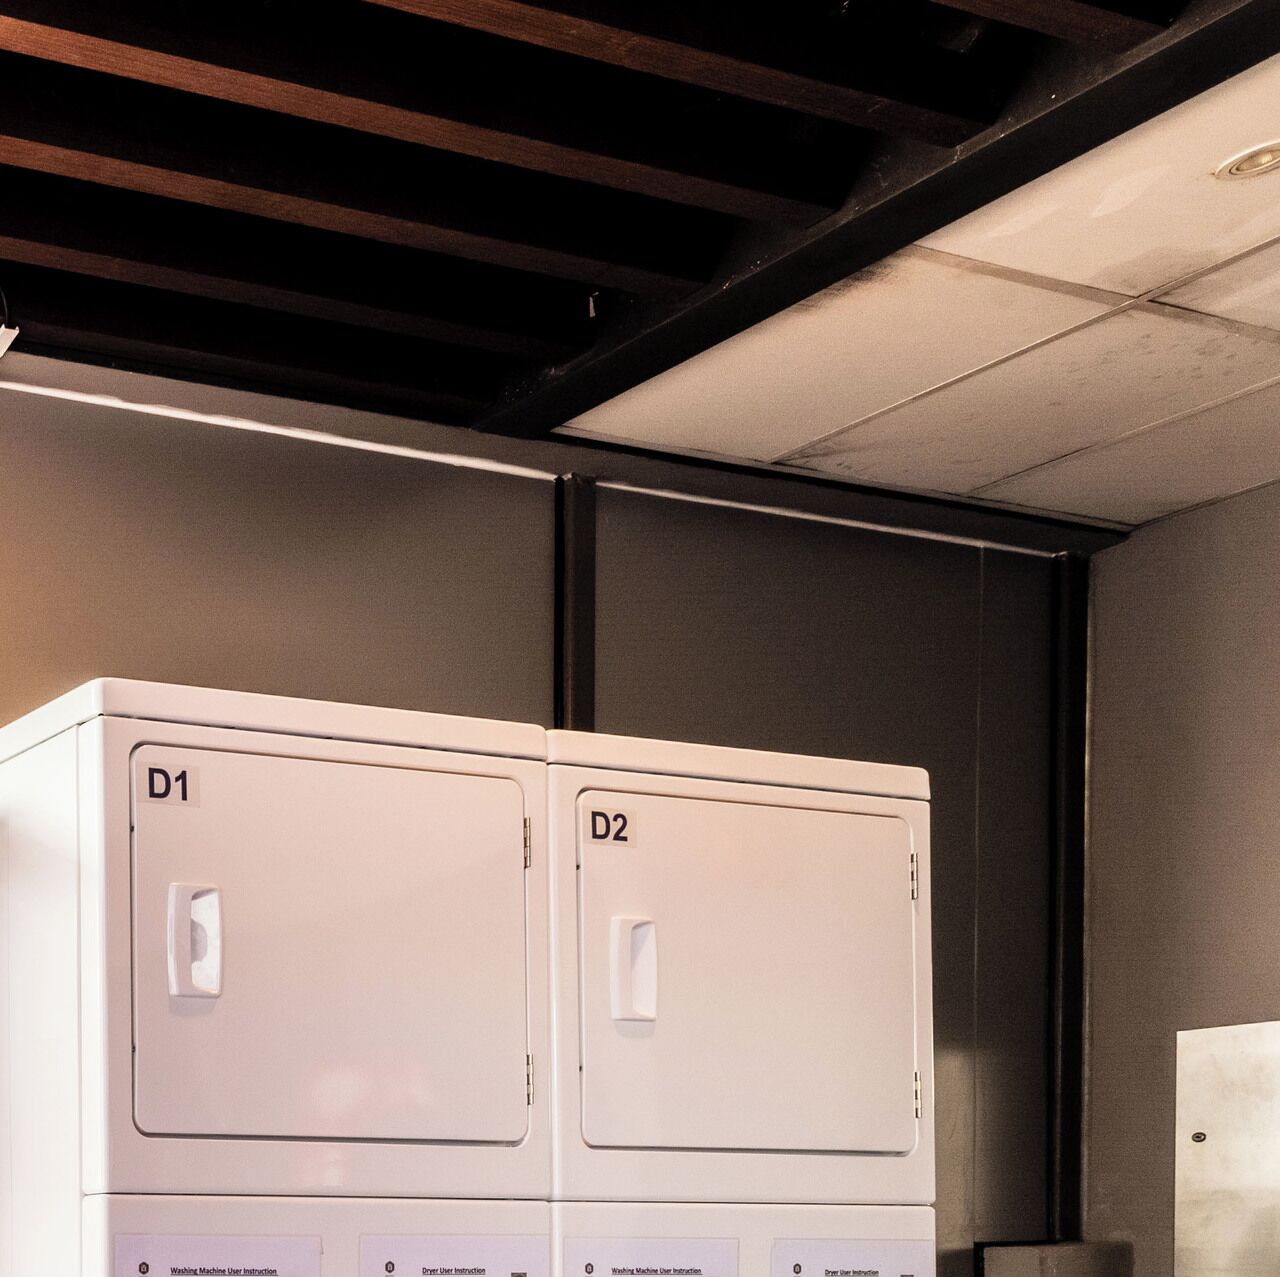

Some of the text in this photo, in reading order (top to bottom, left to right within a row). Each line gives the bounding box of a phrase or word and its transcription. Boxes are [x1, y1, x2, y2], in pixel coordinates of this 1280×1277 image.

[147, 767, 190, 802] D1
[591, 811, 629, 842] D2
[170, 1267, 198, 1275] Washing
[243, 1267, 277, 1275] Instruction
[422, 1267, 439, 1275] Dryer
[611, 1267, 635, 1275] Washing
[824, 1269, 839, 1277] Dryer
